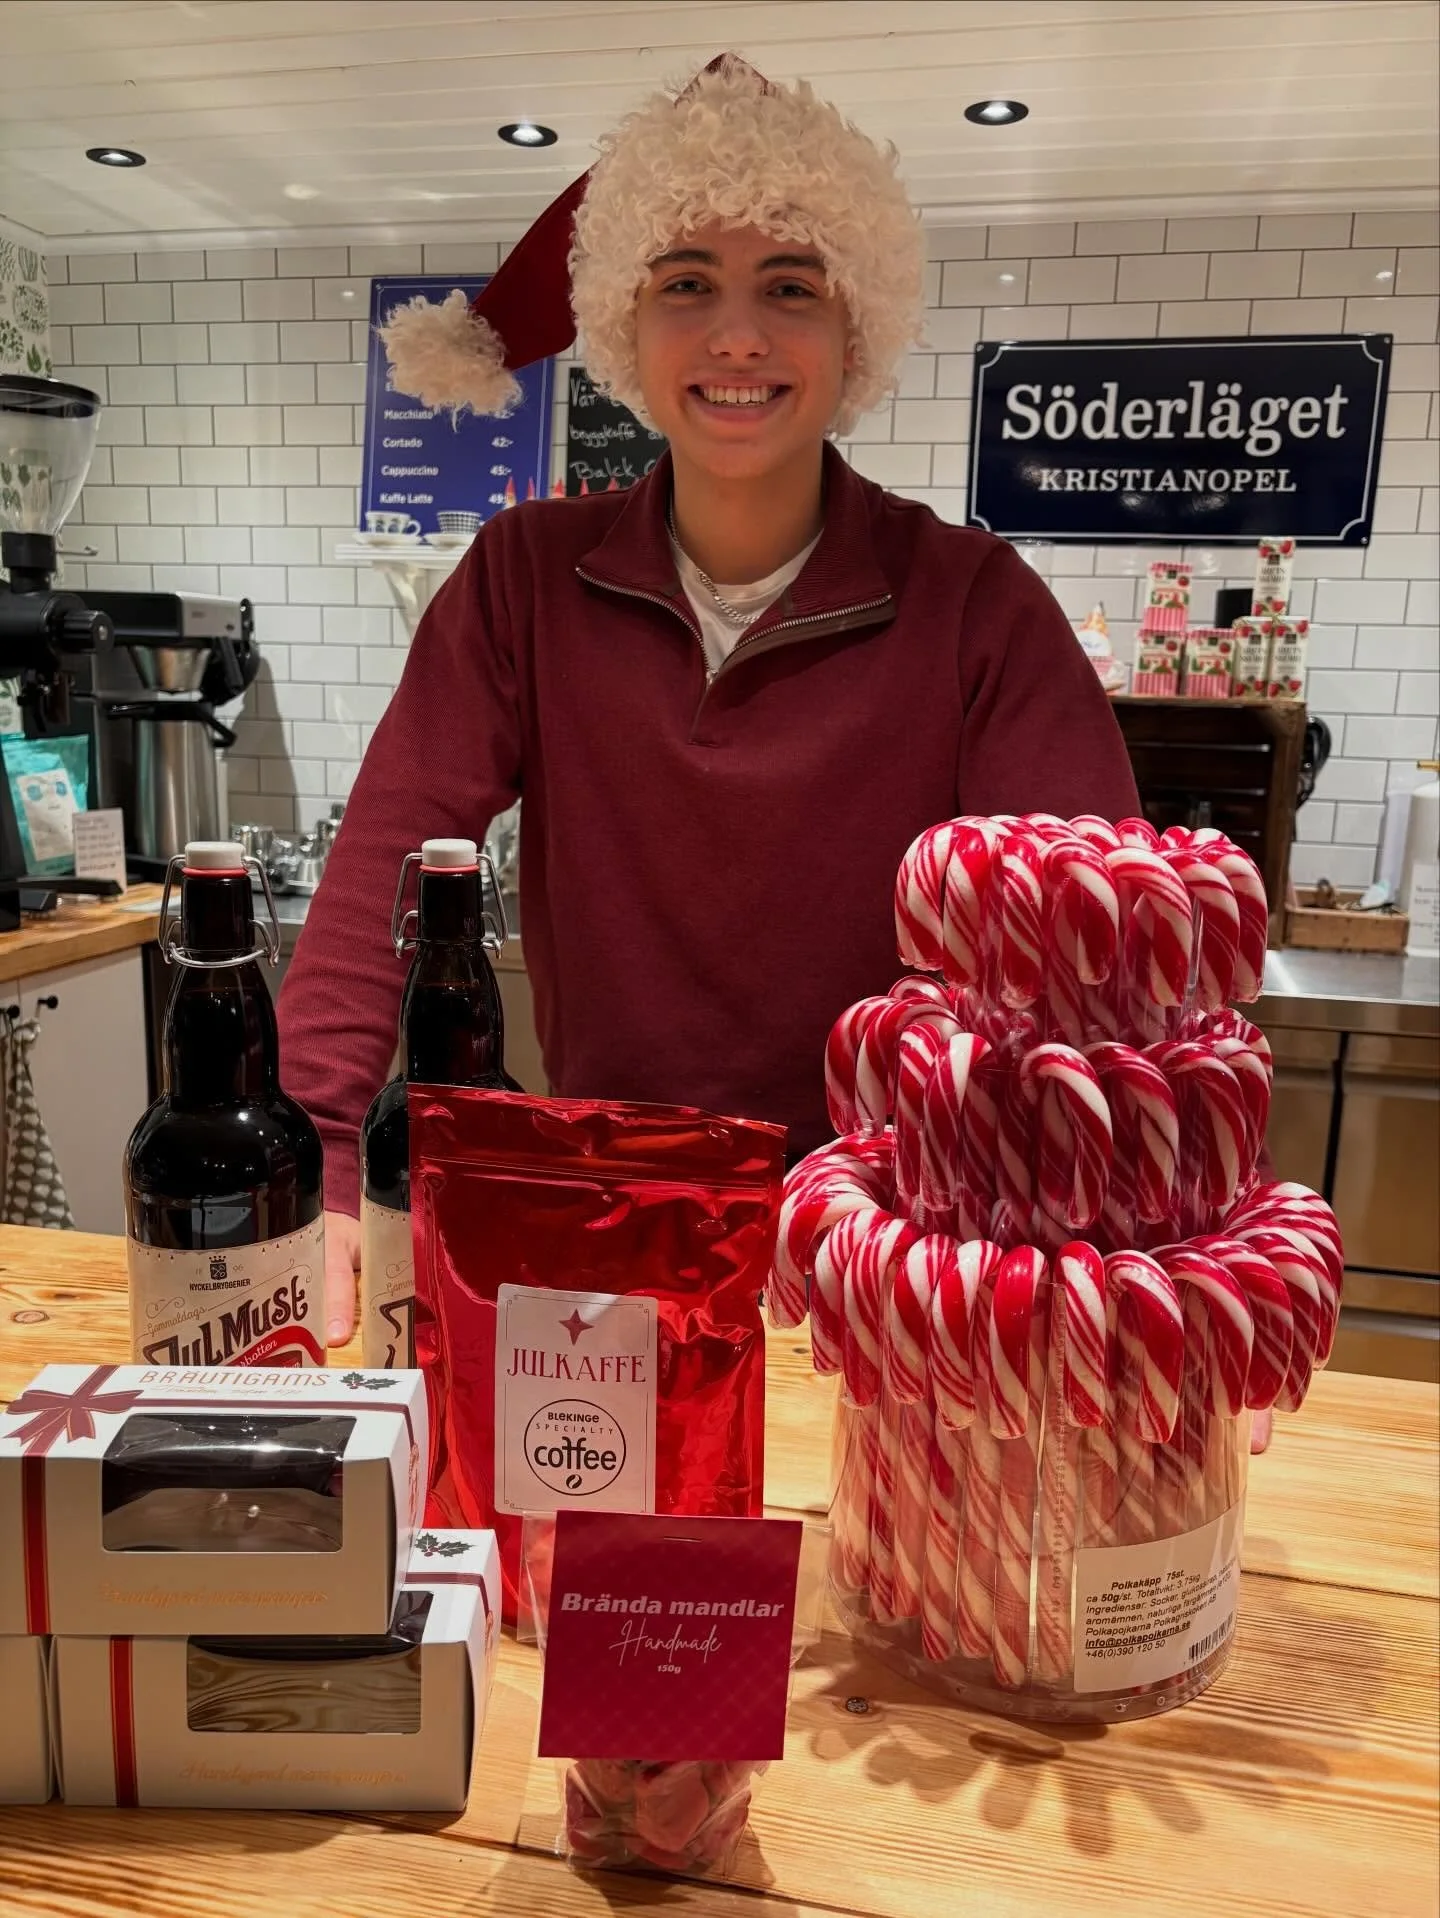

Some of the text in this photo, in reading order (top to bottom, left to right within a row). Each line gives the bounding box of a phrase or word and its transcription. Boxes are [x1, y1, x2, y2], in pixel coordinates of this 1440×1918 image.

[1002, 381, 1348, 457] Söderläget
[382, 437, 423, 448] Cortado
[381, 465, 439, 476] Cappuccino
[1040, 468, 1297, 492] KRISTIANOPEL
[380, 493, 406, 504] Kaffe
[407, 493, 434, 504] Latte
[189, 1278, 251, 1291] NYCKELBRYGGERIER
[507, 1347, 646, 1383] JULKAFFE
[139, 1370, 331, 1387] BRÄUTIGAMS
[536, 1423, 614, 1435] SPECIALTY
[533, 1436, 617, 1471] coffee
[1111, 1577, 1162, 1591] Polkakäpp
[561, 1593, 785, 1617] Brända mandlar
[1086, 1595, 1098, 1603] ca
[1085, 1622, 1151, 1637] Polkapojkarna
[609, 1618, 722, 1666] Handmade
[1085, 1639, 1166, 1660] +46(0)390 120 50
[657, 1664, 681, 1674] 150g
